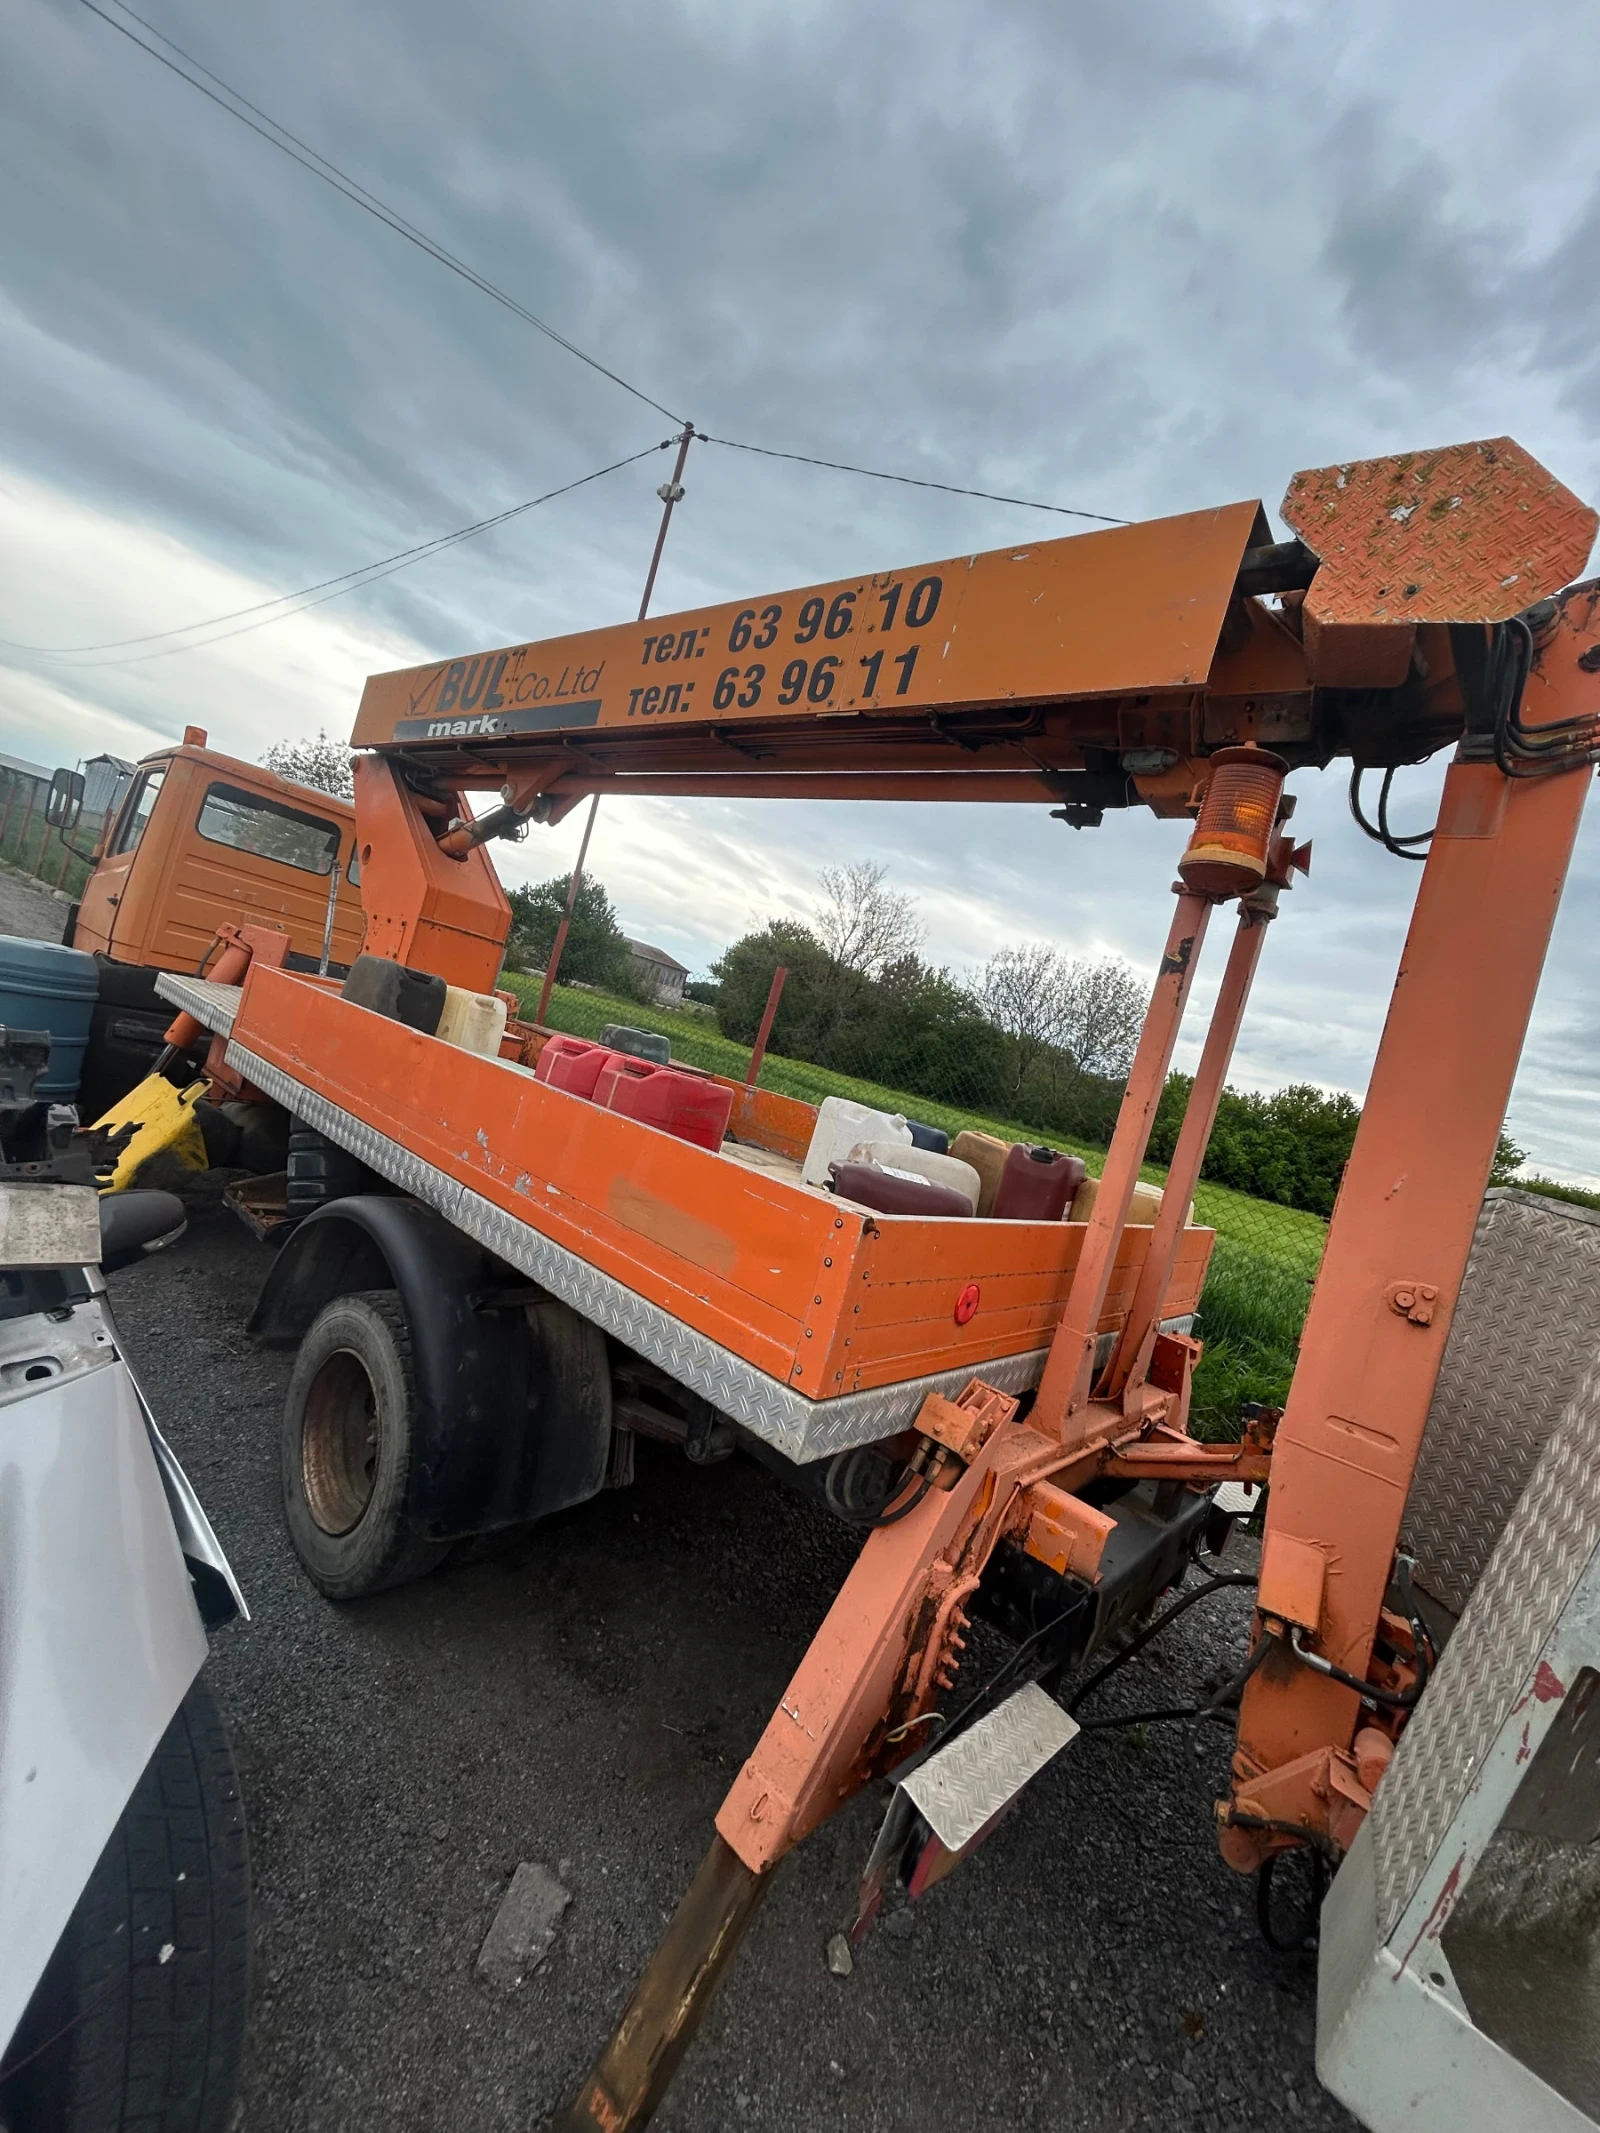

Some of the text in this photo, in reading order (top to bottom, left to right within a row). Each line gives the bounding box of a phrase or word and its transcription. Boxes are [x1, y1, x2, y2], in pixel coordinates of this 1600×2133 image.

[641, 576, 943, 665] тел: 63 96 10
[627, 644, 920, 717] тел: 63 96 11
[427, 714, 499, 737] mark
